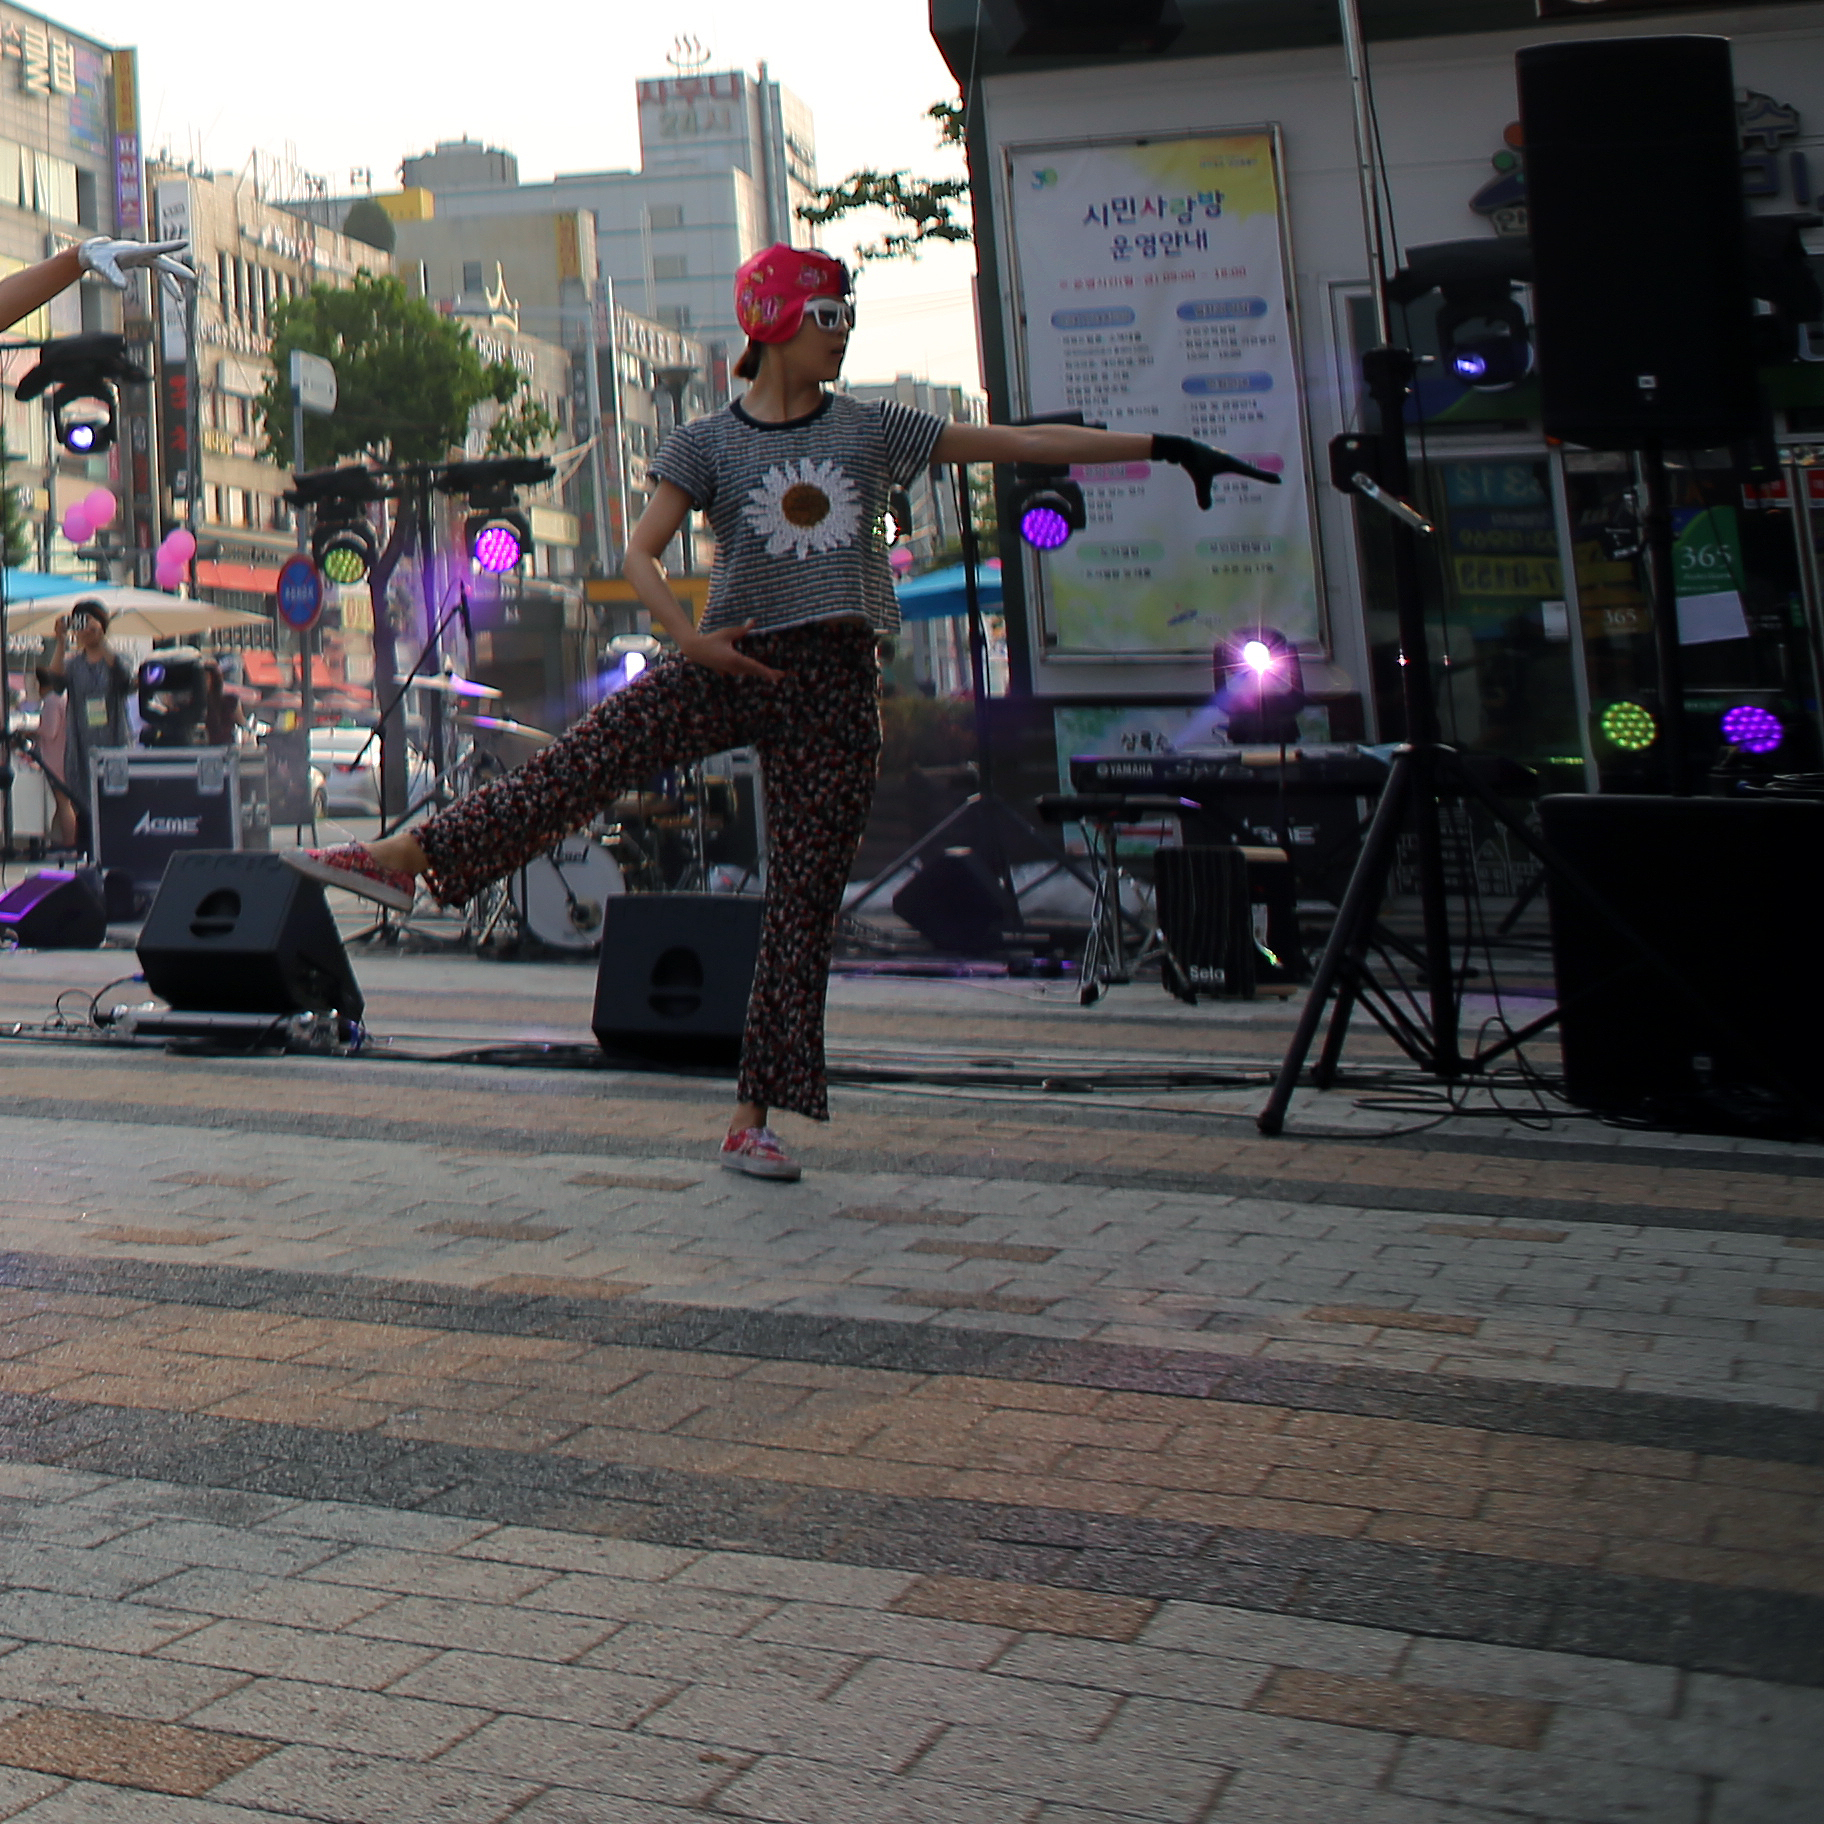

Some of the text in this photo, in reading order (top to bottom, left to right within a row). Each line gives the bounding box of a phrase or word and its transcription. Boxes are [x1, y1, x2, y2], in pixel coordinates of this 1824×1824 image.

[1082, 188, 1226, 229] 시민사랑방
[1110, 228, 1209, 262] 운영안내
[1679, 542, 1734, 570] 365
[1110, 763, 1154, 776] YAMAHA
[132, 809, 202, 836] ACME
[1189, 963, 1226, 983] Sela
